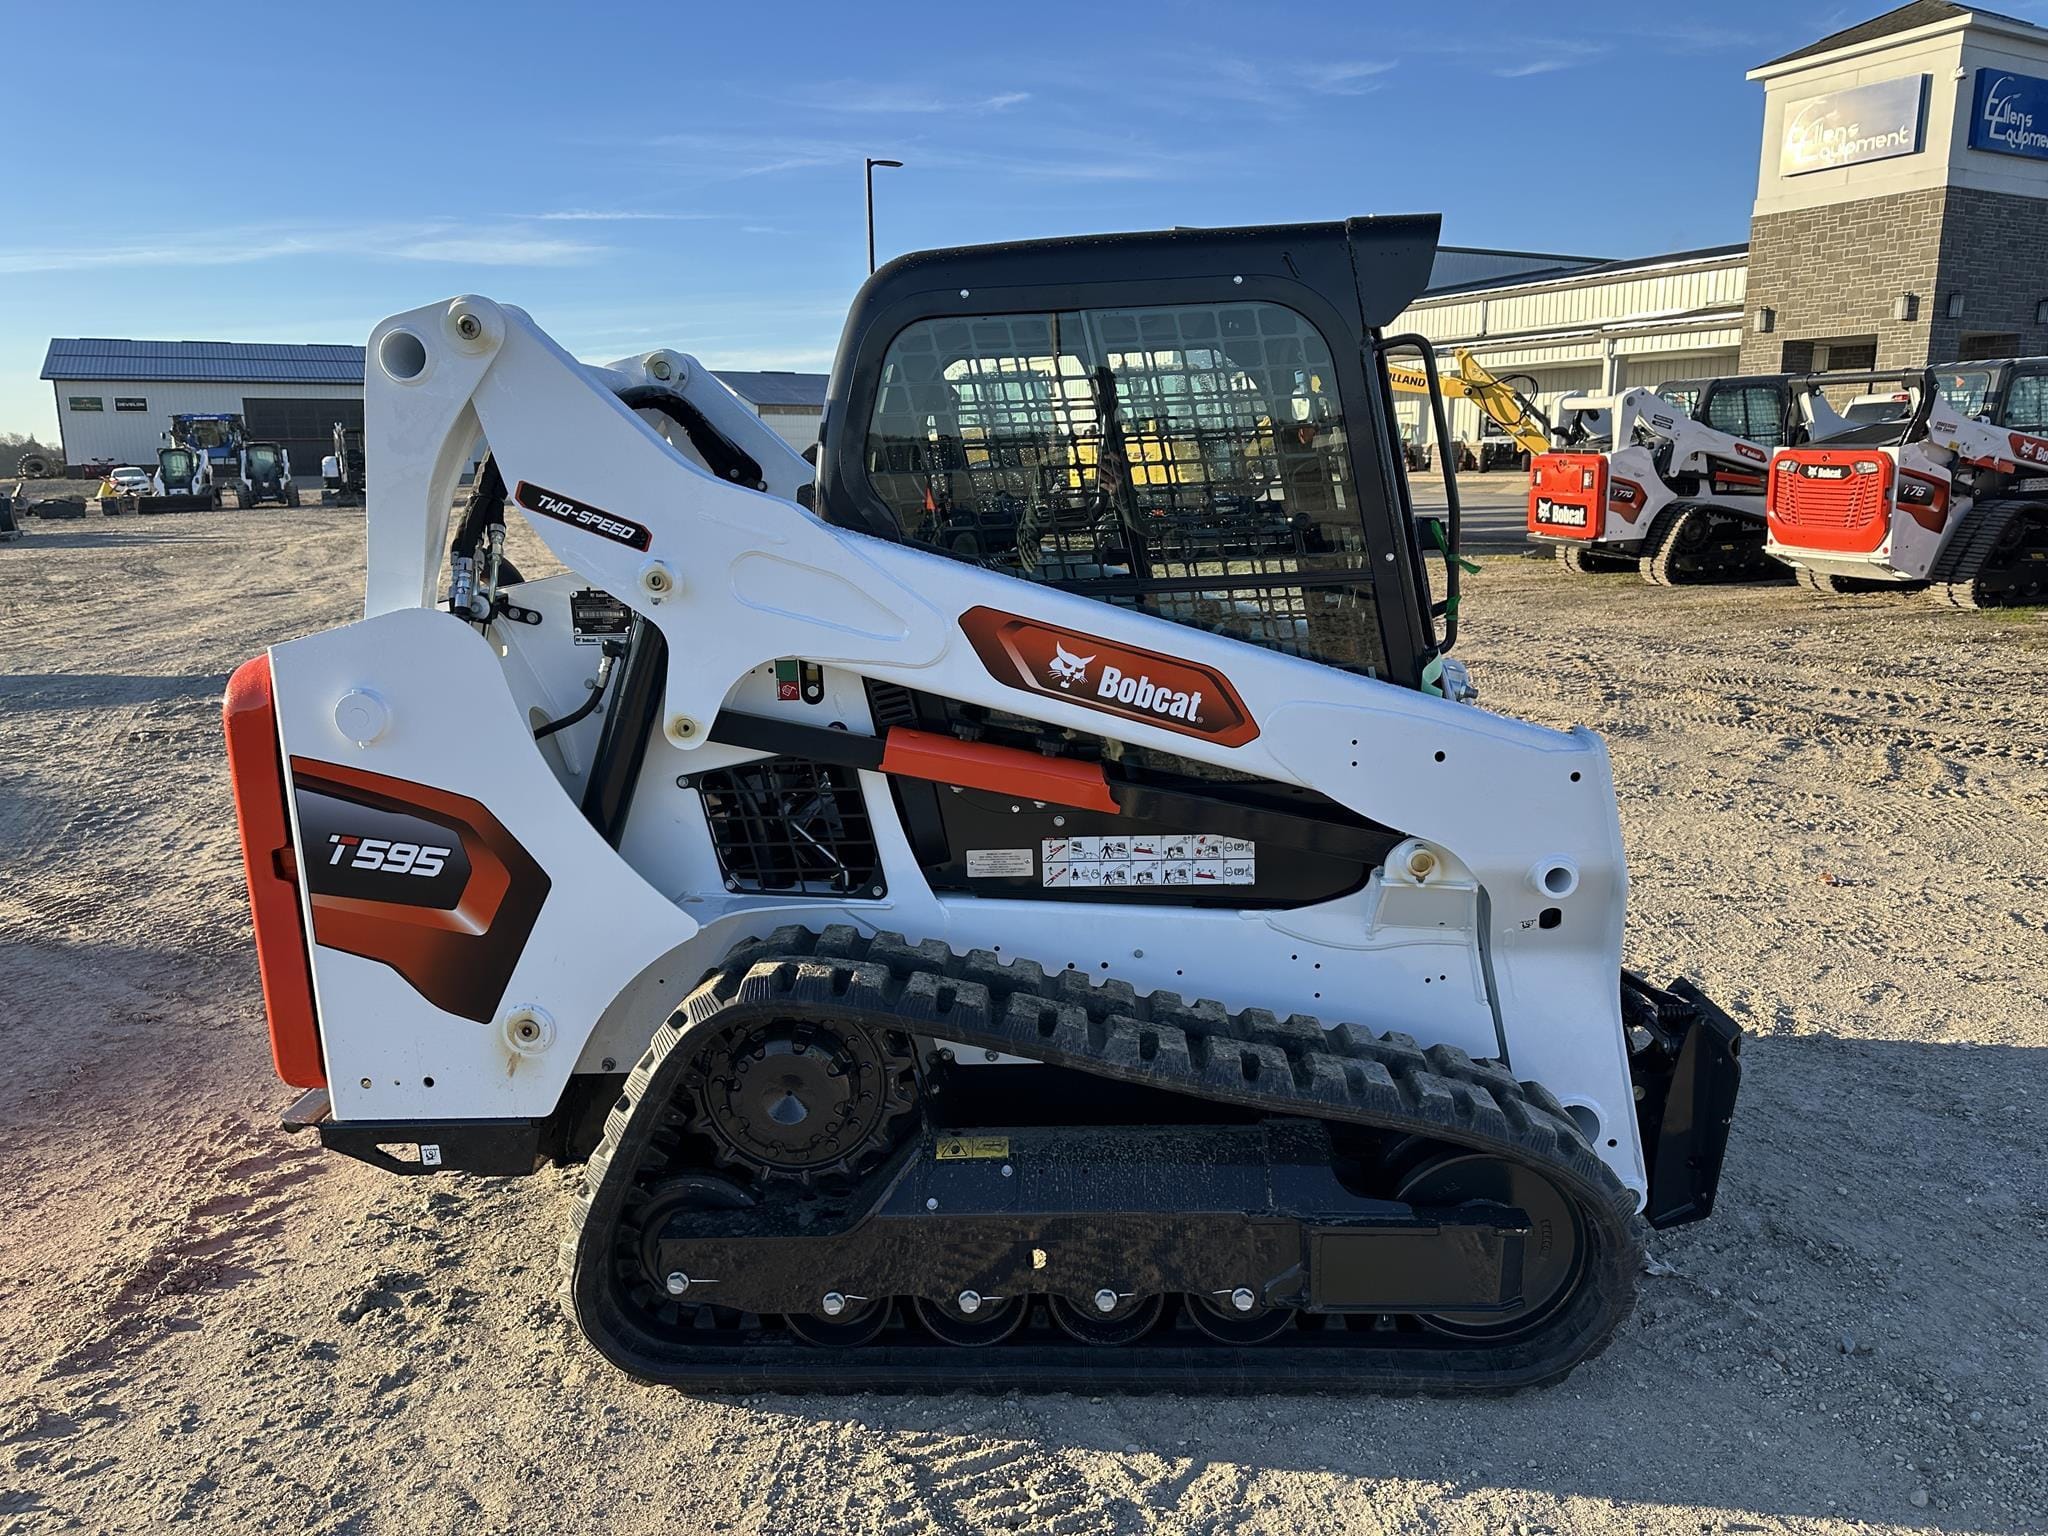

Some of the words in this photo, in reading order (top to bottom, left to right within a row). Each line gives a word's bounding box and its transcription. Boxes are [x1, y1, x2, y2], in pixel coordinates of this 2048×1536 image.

[1787, 99, 1860, 150] Ellens
[1984, 76, 2033, 130] Ellens
[1989, 93, 2048, 150] Equipme
[537, 494, 636, 540] TWO-SPEED
[1552, 504, 1586, 525] Bobcat
[1097, 664, 1203, 723] Bobcat
[328, 834, 451, 878] T595
